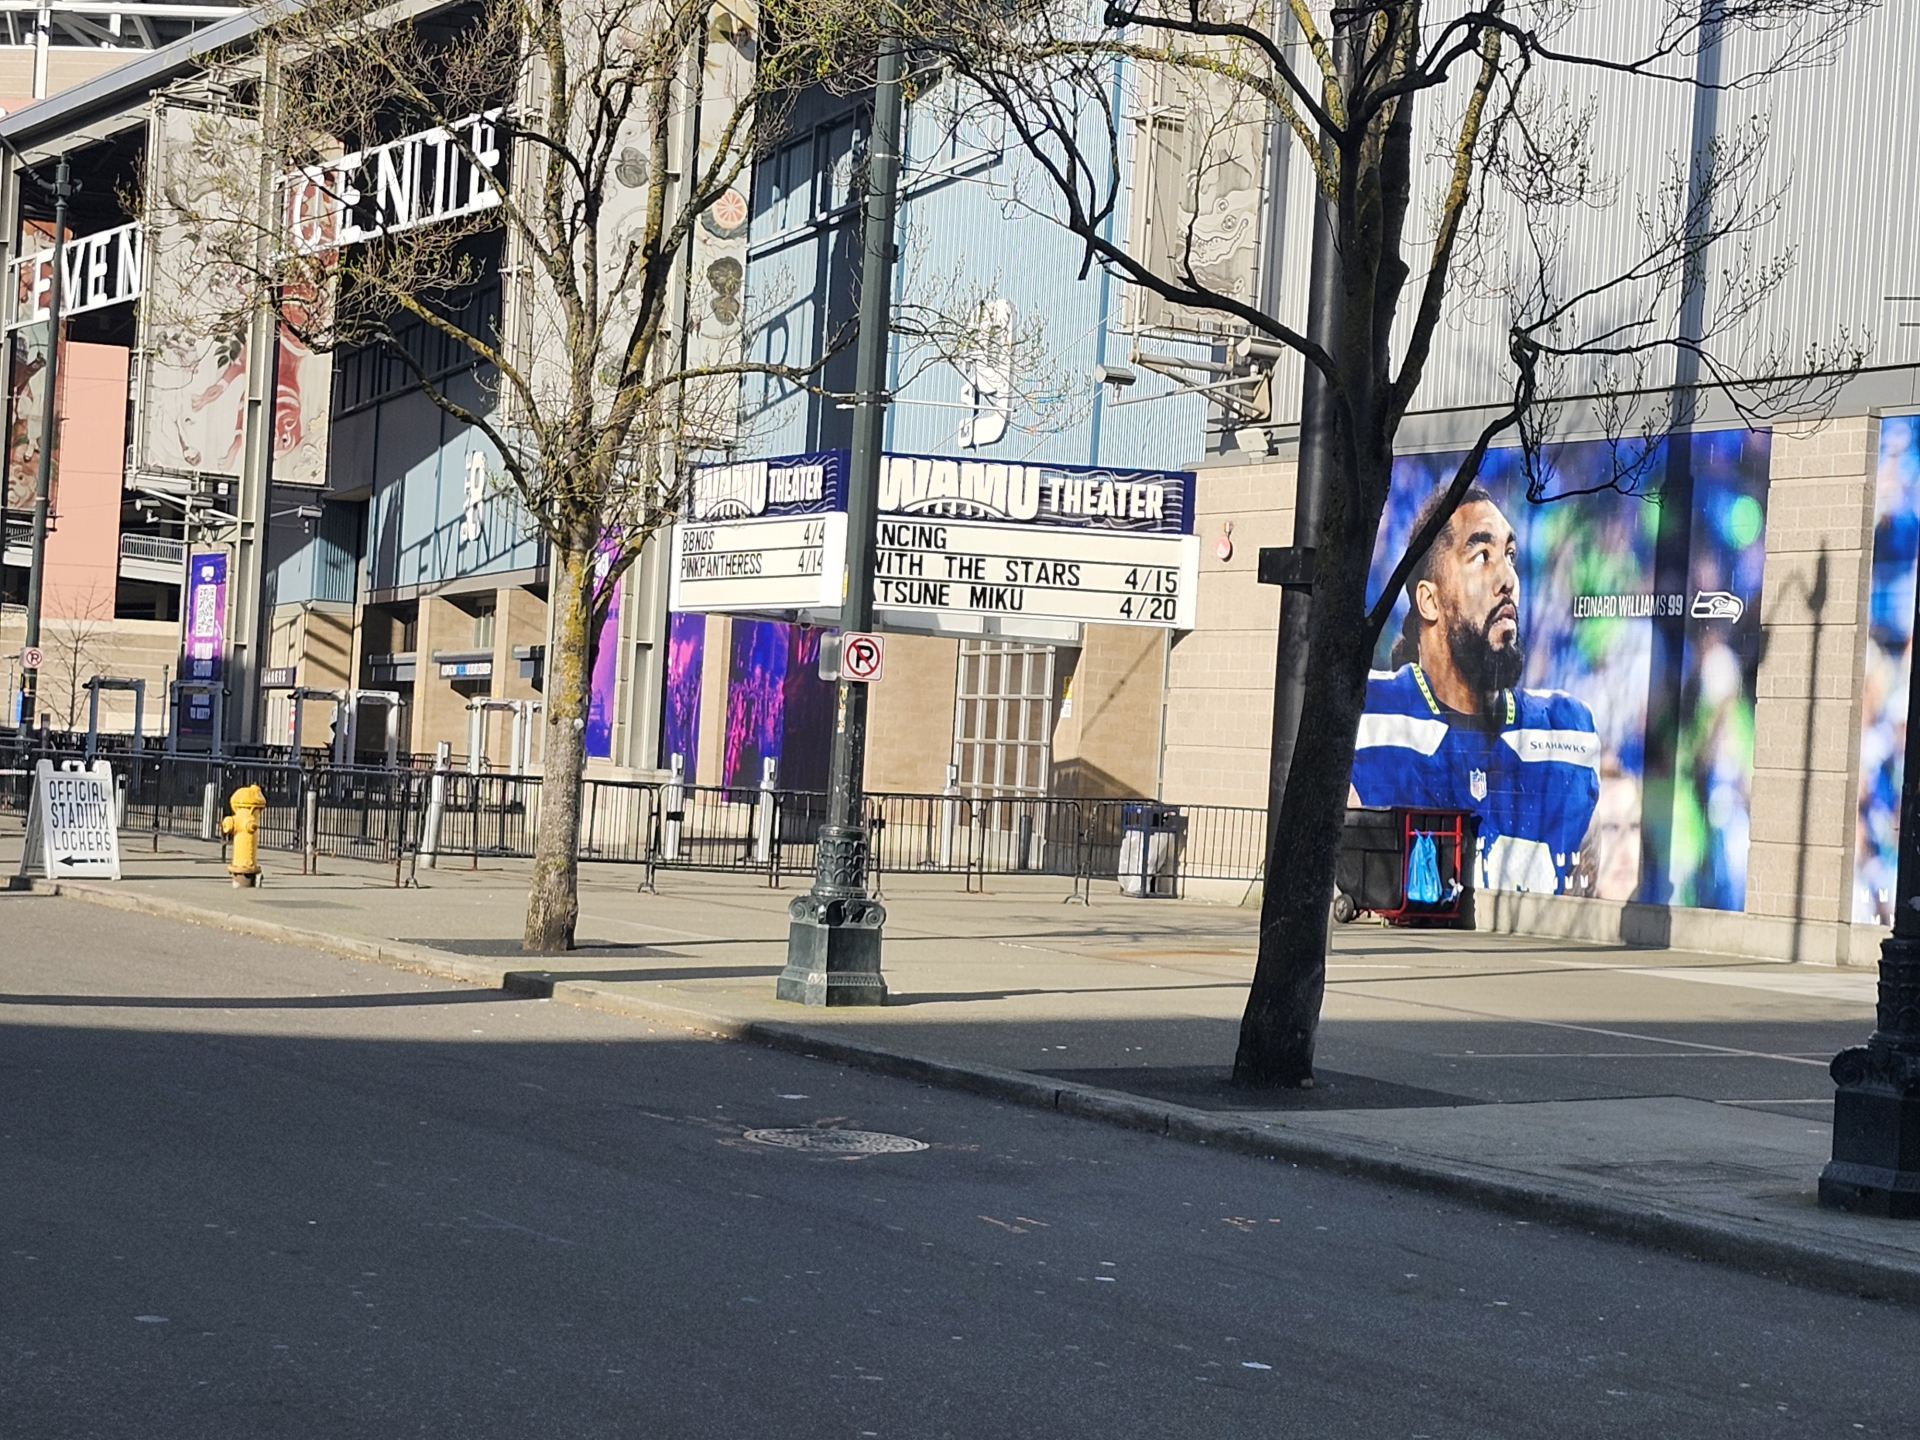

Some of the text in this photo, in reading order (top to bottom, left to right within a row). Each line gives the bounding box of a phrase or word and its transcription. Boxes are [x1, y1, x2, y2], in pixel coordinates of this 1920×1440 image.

[694, 461, 823, 519] WAMU THEATER
[877, 455, 1164, 520] WAMU THEATER
[803, 522, 825, 546] 4/4
[876, 523, 947, 550] NCING
[681, 549, 823, 578] PINKPANTHERESS 4/14
[944, 556, 986, 580] THE
[1005, 560, 1081, 587] STARS
[1125, 568, 1178, 594] 4/15
[873, 580, 1177, 621] TSUNE MIKU 4/20
[1573, 594, 1684, 618] LEONARD WILLIAMS 99
[1530, 741, 1587, 754] SEAHAWKS
[49, 780, 107, 802] OFFICIAL
[51, 802, 109, 829] STADIUM
[53, 830, 111, 851] LOCKERS
